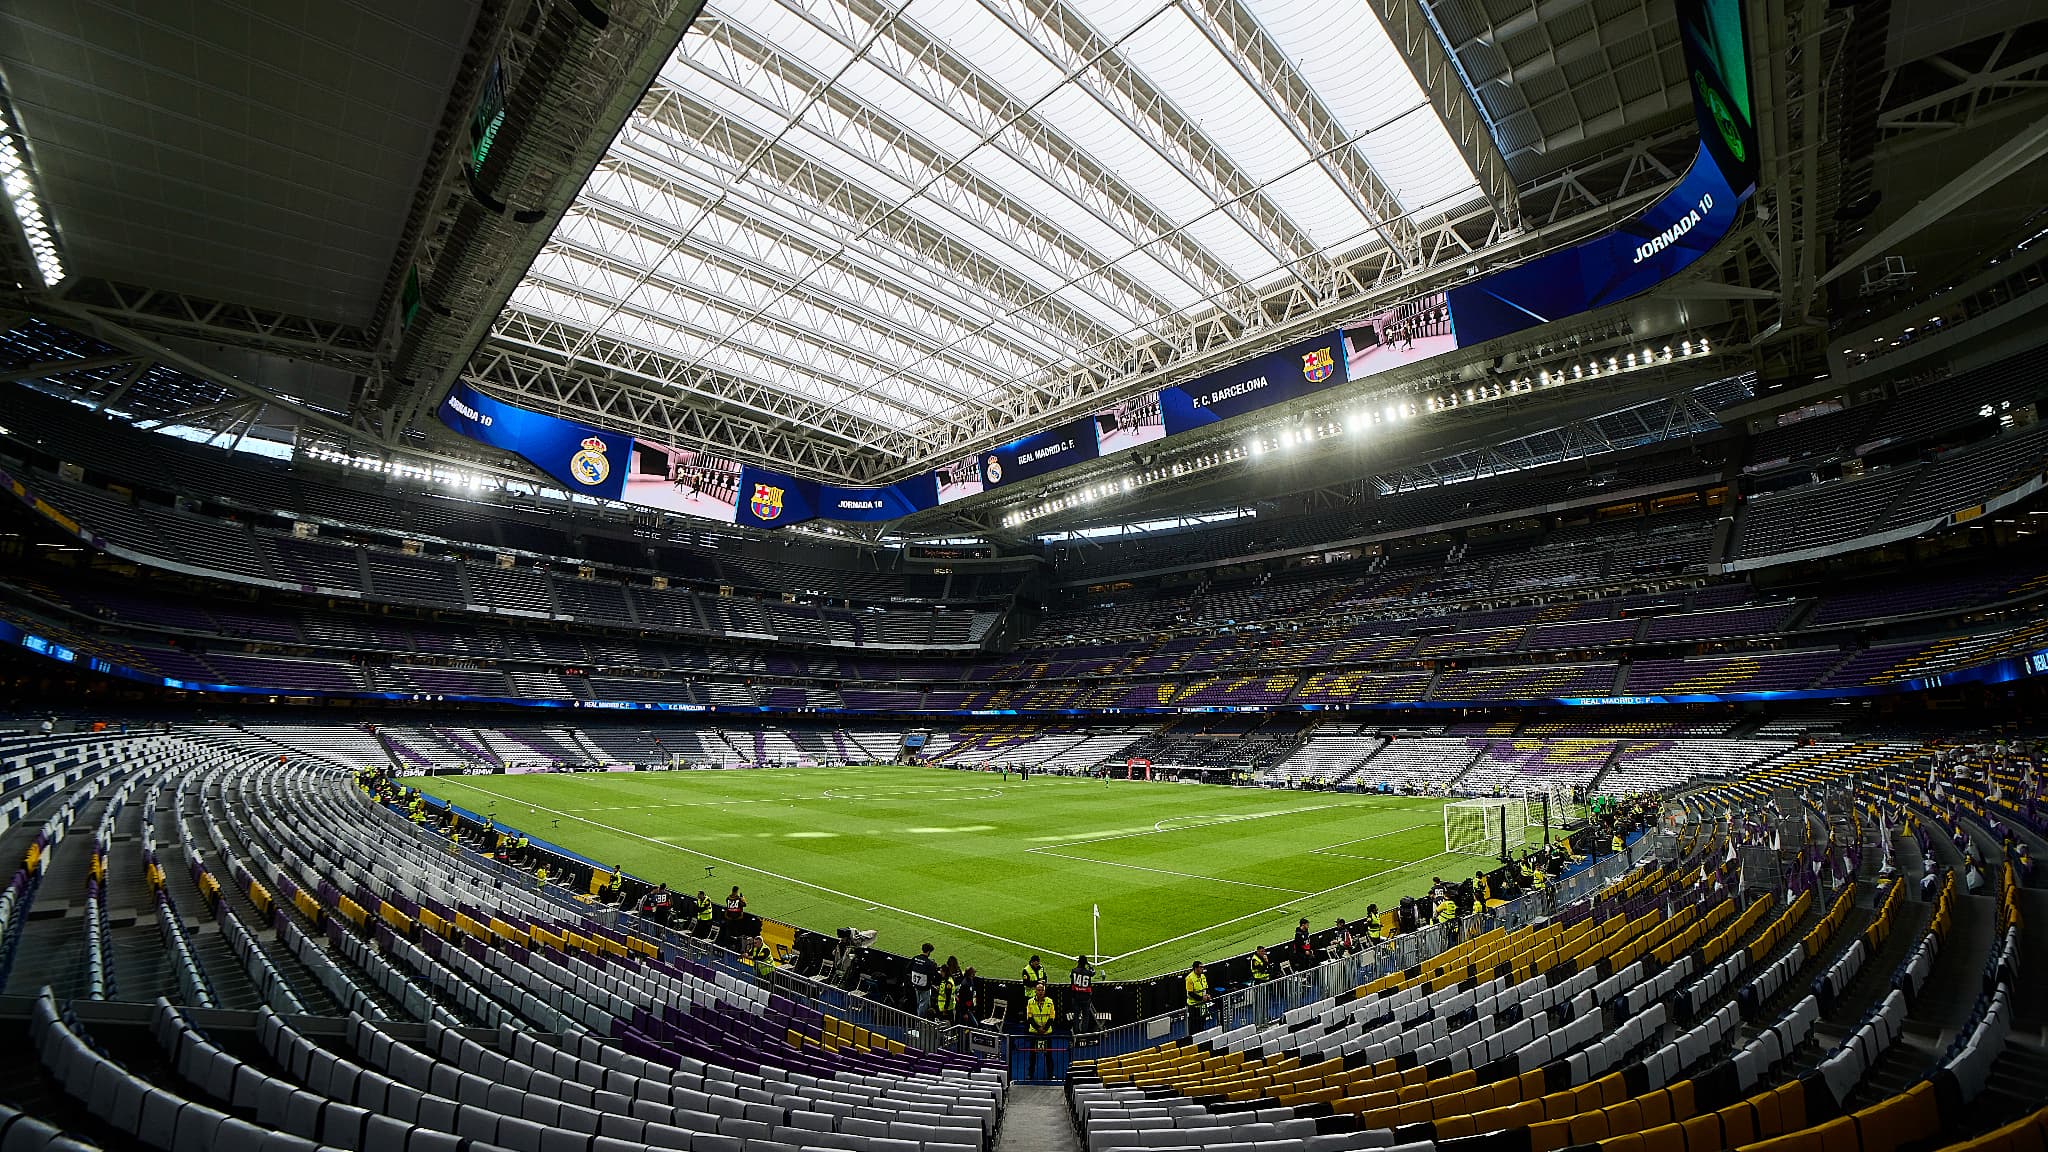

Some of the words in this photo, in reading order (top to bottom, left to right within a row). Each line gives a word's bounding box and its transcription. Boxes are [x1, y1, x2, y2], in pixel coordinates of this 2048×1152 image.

[1633, 209, 1701, 264] JORNADA
[1698, 193, 1714, 215] 10
[1192, 398, 1201, 409] F.
[1201, 395, 1211, 406] C.
[1212, 375, 1269, 404] BARCELONA
[480, 414, 493, 427] 10
[1018, 452, 1035, 465] REAL
[1034, 443, 1061, 460] MADRID
[838, 500, 873, 509] JORNADA
[874, 500, 883, 509] 10
[402, 769, 426, 777] BMW
[472, 768, 494, 776] BMW
[1072, 972, 1090, 988] 146
